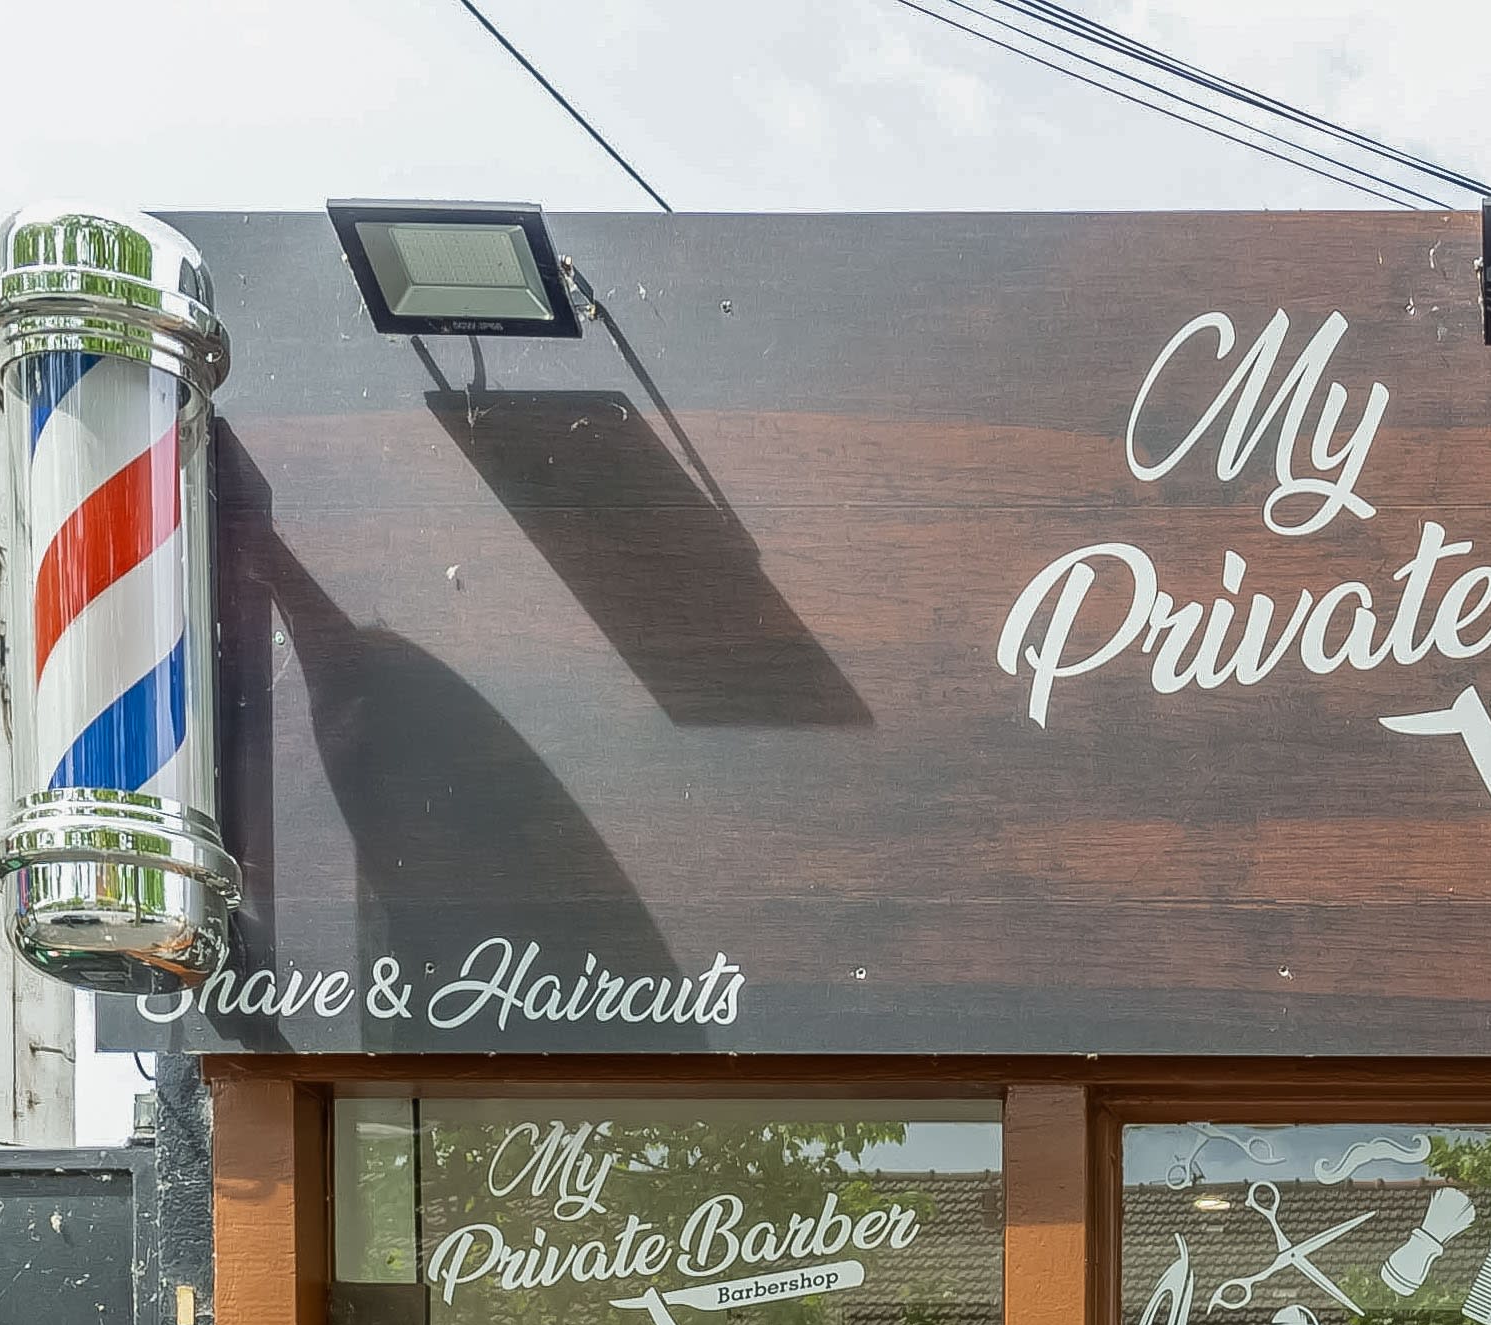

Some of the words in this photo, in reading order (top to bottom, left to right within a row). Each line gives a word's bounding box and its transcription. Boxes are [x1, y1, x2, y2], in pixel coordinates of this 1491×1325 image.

[1125, 308, 1389, 535] My
[366, 956, 413, 1019] &
[429, 938, 746, 1030] Haircuts
[488, 1120, 613, 1222] My
[427, 1215, 672, 1305] Private
[678, 1192, 920, 1277] Barber
[717, 1268, 839, 1304] Barbershop
